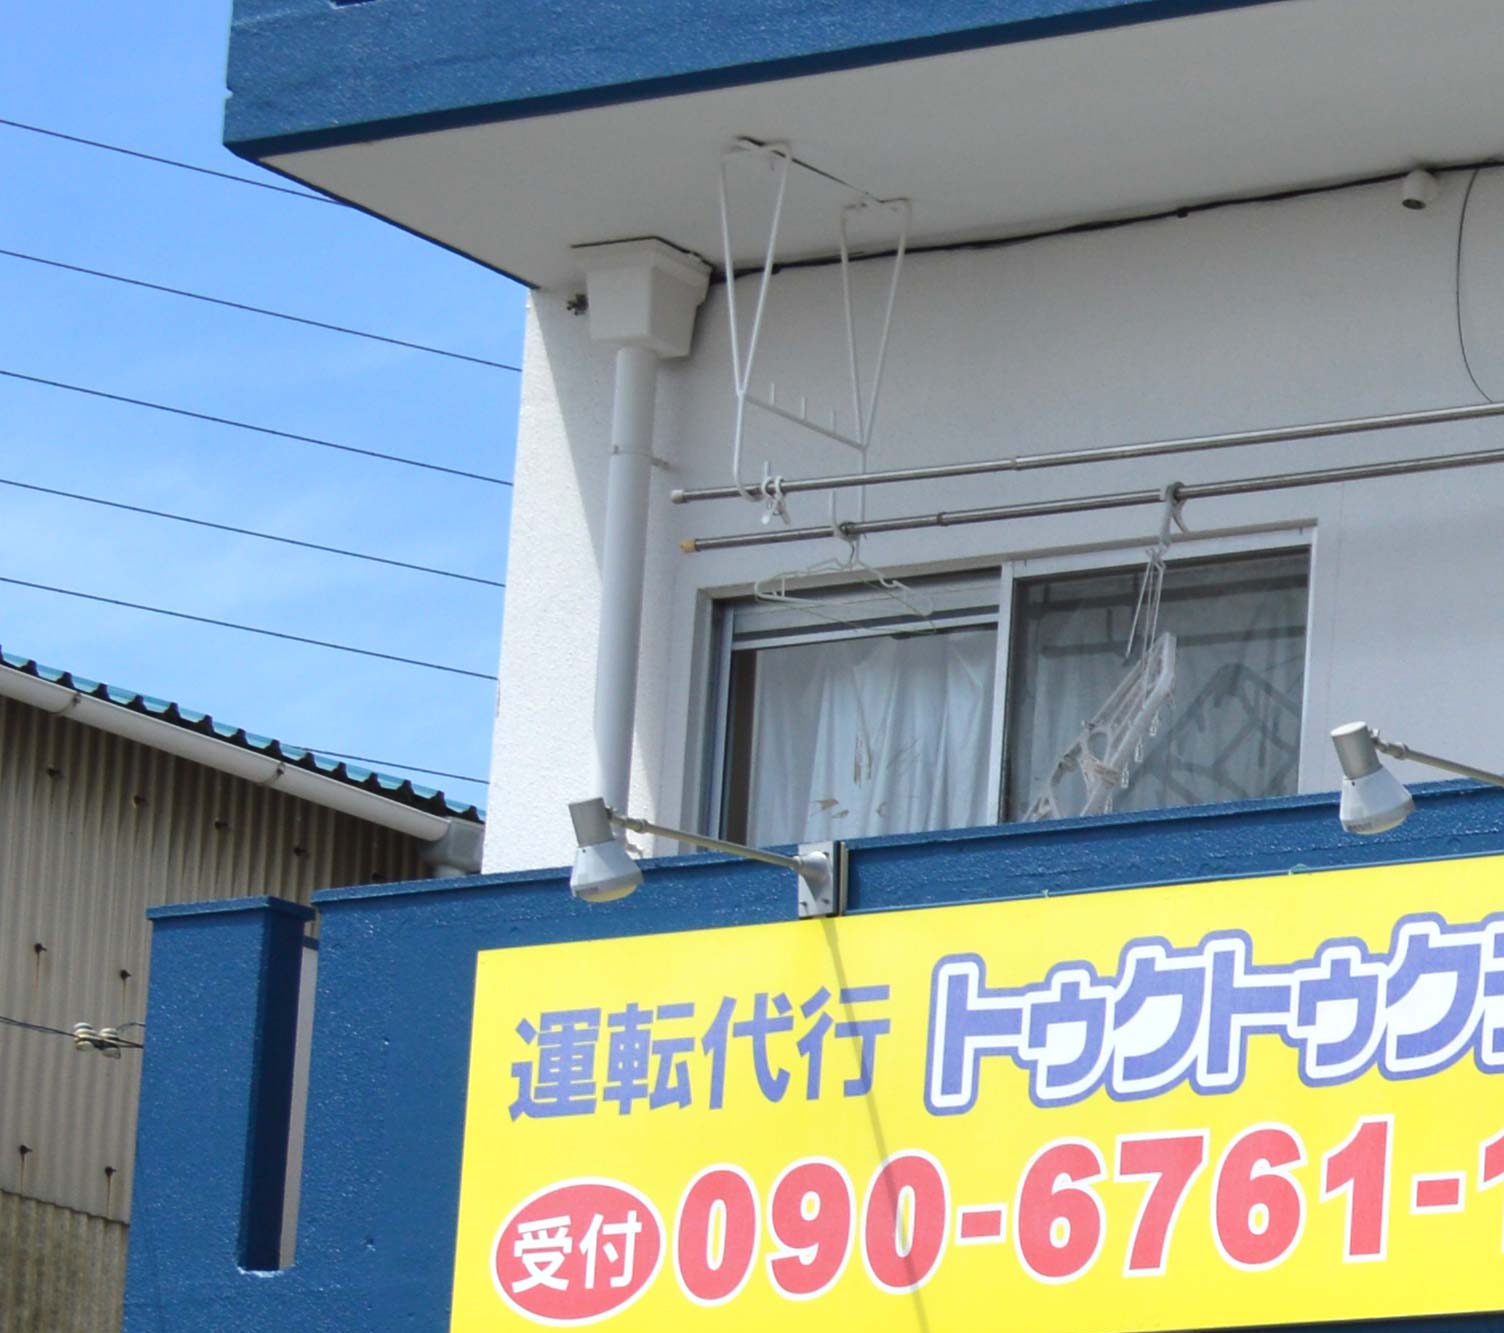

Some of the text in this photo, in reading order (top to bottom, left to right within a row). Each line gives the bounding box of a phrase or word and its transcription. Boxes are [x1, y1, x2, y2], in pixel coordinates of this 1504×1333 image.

[509, 984, 890, 1121] 運転代行
[510, 1214, 645, 1296] 受付
